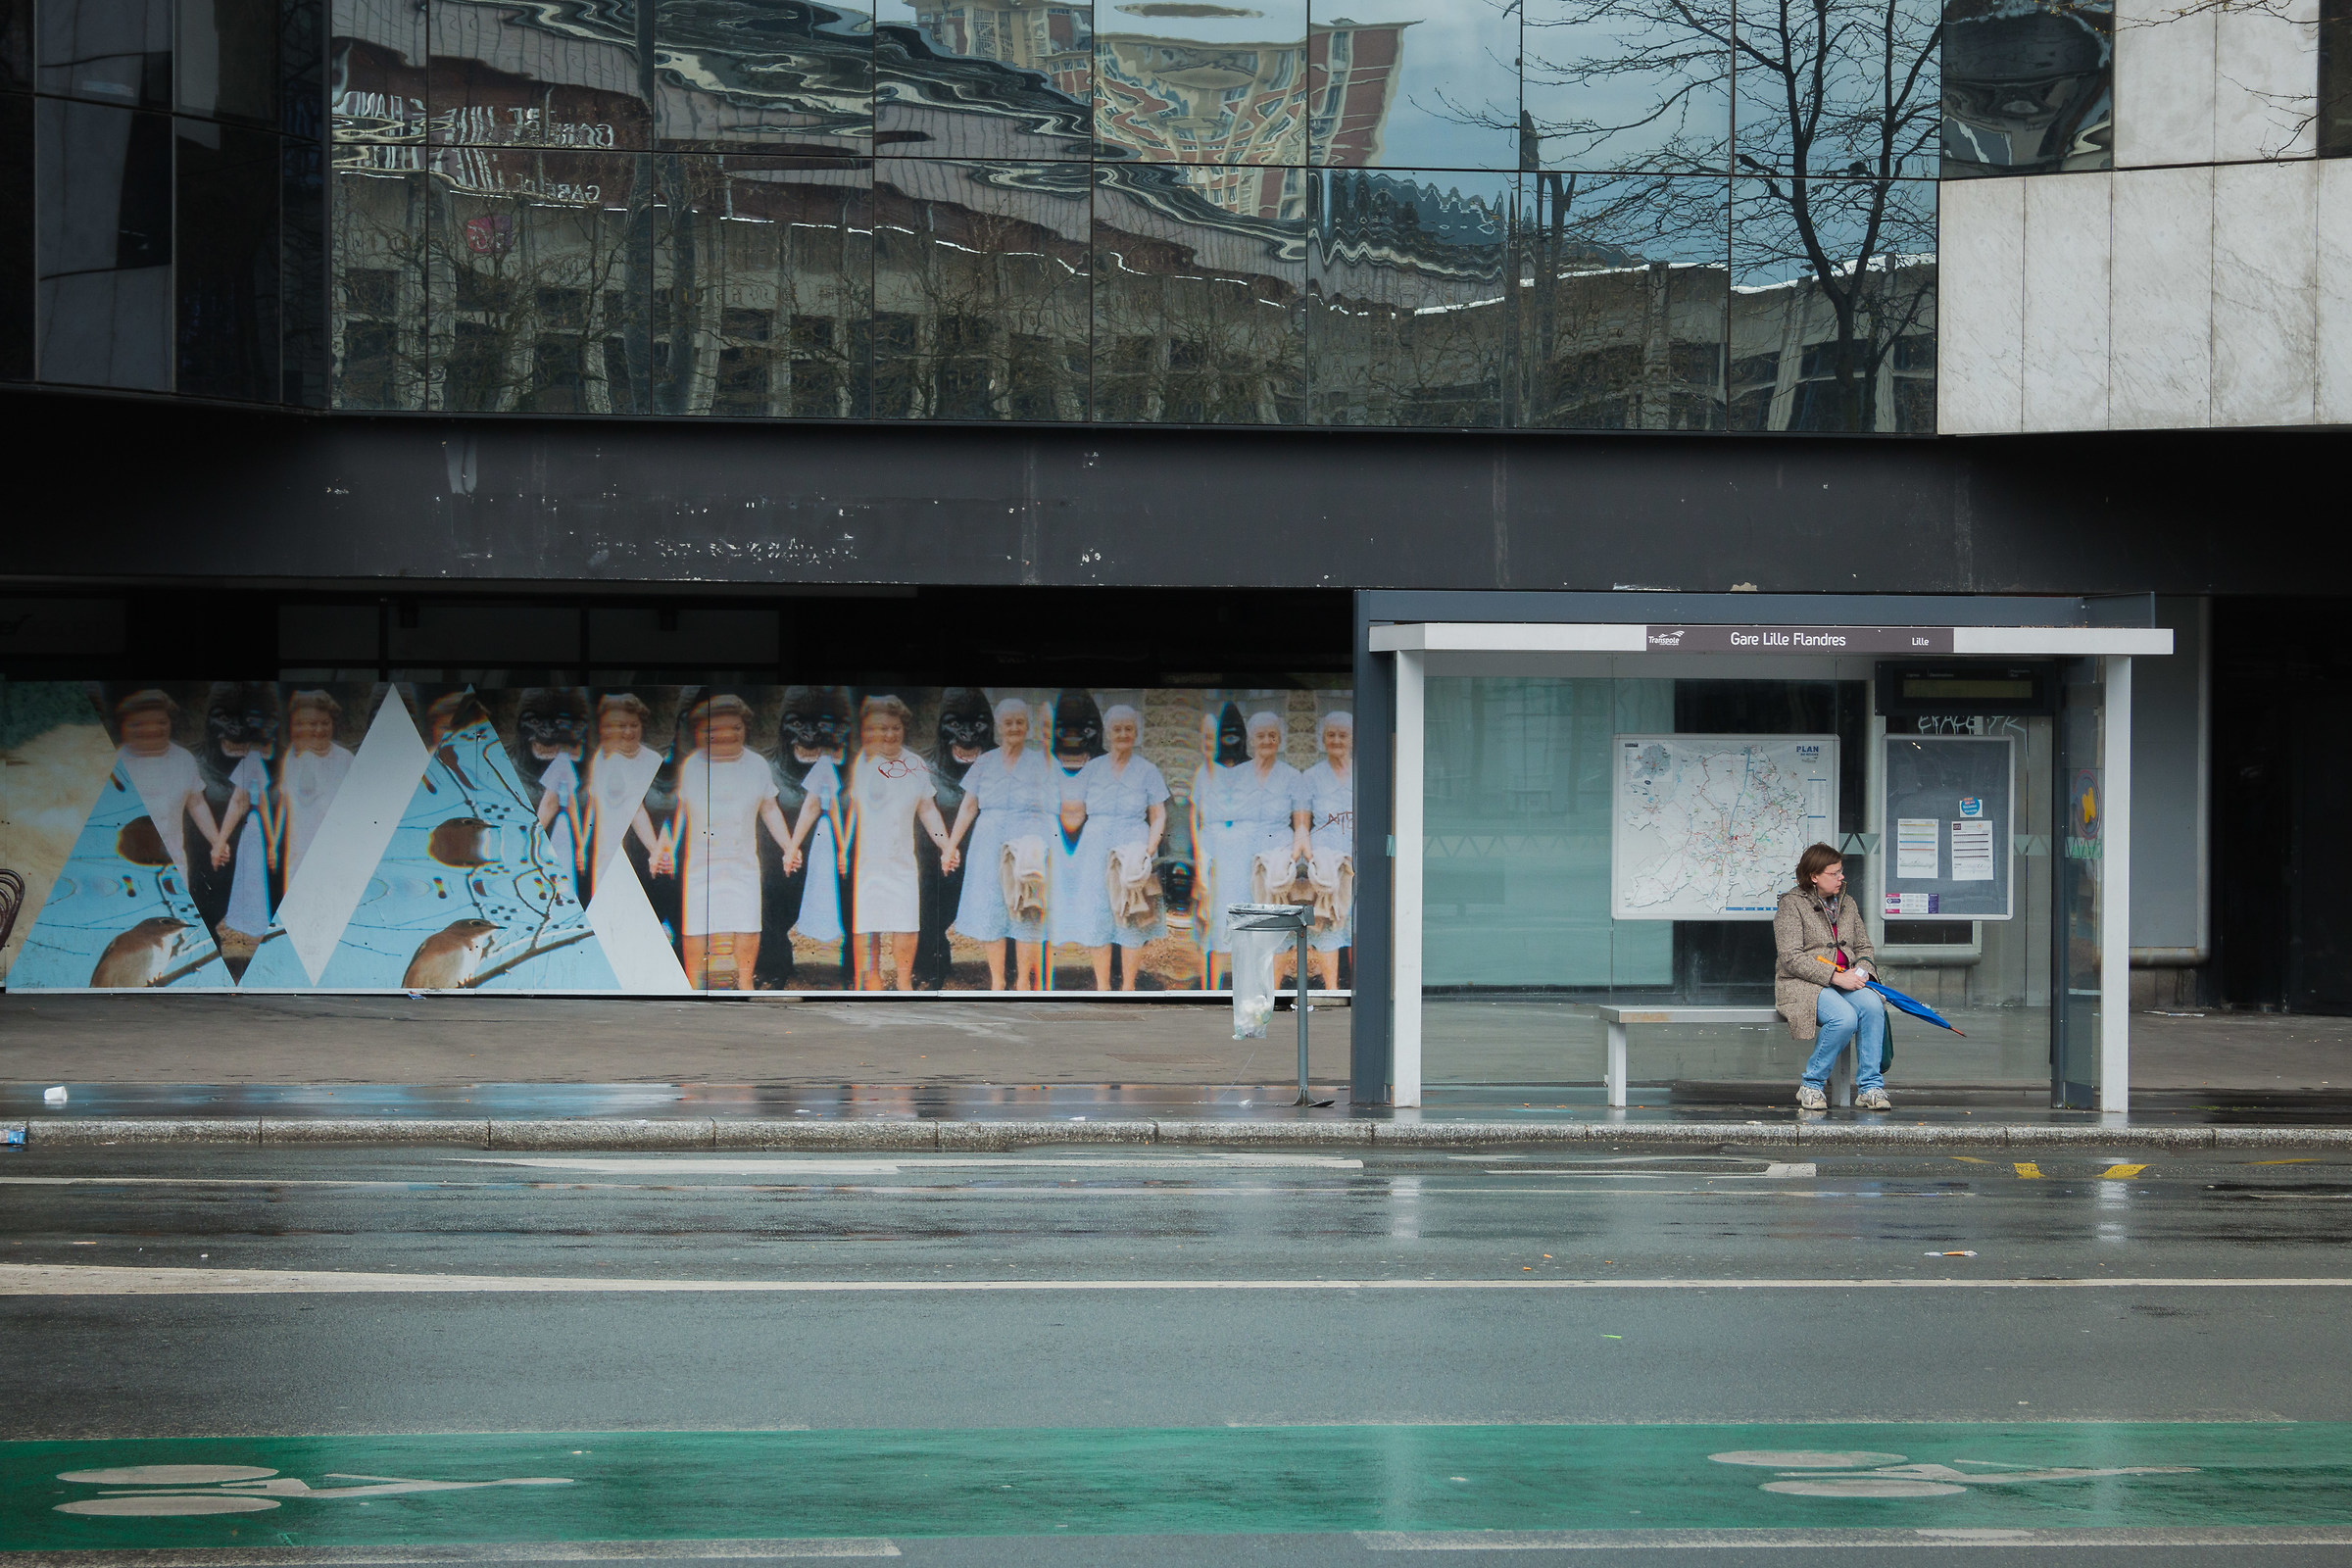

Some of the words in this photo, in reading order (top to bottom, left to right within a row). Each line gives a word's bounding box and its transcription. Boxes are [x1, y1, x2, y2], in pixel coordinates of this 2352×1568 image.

[1647, 635, 1680, 645] Transpole
[1730, 632, 1759, 646] Gare
[1763, 632, 1789, 646] Lille
[1793, 632, 1846, 647] Flandres
[1912, 637, 1930, 647] Lille
